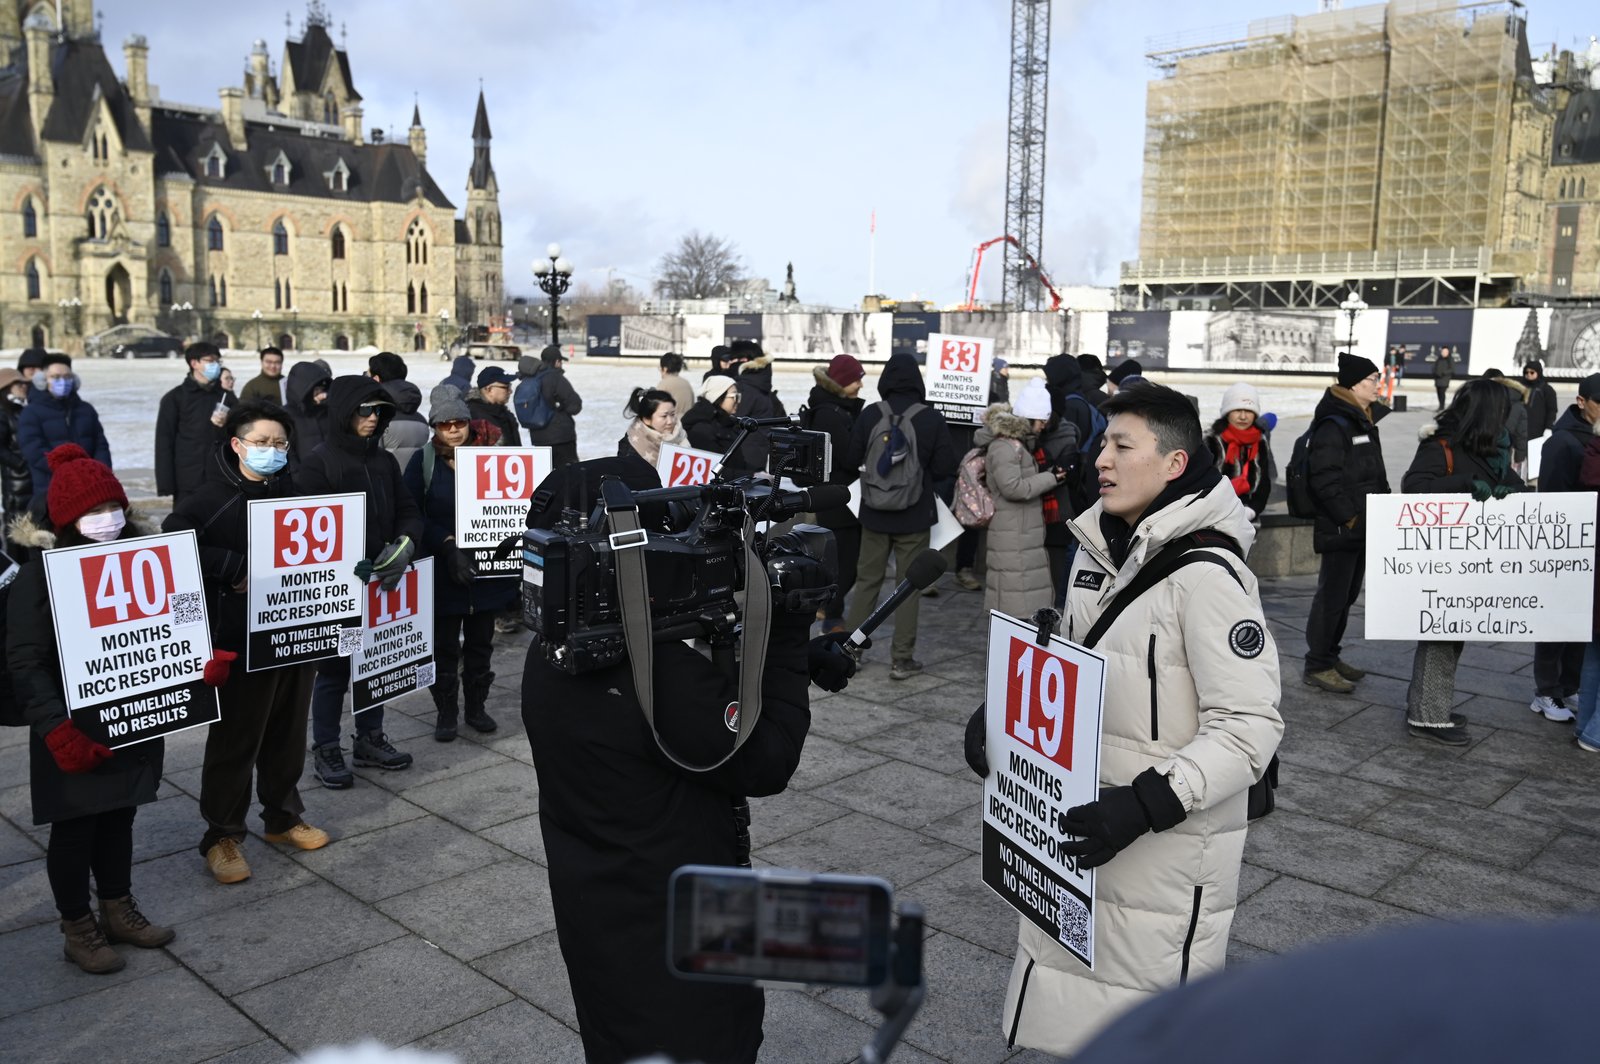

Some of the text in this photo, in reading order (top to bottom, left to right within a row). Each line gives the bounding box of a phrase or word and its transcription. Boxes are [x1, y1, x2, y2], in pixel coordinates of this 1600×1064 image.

[943, 341, 977, 372] 33
[933, 382, 981, 393] WAITING FOR
[942, 374, 973, 383] MONTHS
[928, 390, 984, 402] IRCC RESPONSE
[945, 411, 972, 420] RESULTS
[483, 455, 526, 499] 19
[671, 454, 706, 487] 28
[470, 518, 516, 529] WAITING
[482, 505, 528, 516] MONTHS
[1395, 500, 1567, 527] ASSEZ des délais
[281, 506, 337, 566] 39
[464, 532, 488, 543] IRCC
[1397, 522, 1595, 551] INTERMINABLE
[475, 550, 488, 560] NO
[479, 560, 524, 571] NO RESUL
[705, 555, 728, 565] SONY
[1383, 557, 1593, 578] Nos vies sont en suspens.
[95, 549, 167, 622] 40
[280, 568, 336, 588] MONTHS
[266, 583, 349, 607] WAITING FOR
[376, 573, 411, 625] 11
[1422, 589, 1545, 613] Transparence.
[257, 598, 356, 625] IRCC RESPONSE
[1420, 610, 1534, 634] Délais clairs.
[101, 624, 172, 652] MONTHS
[270, 624, 342, 646] NO TIMELINES
[363, 631, 423, 660] WAITING FOR
[373, 621, 414, 643] MONTHS
[85, 640, 192, 676] WAITING FOR
[274, 637, 338, 658] NO RESULTS
[358, 642, 429, 676] IRCC RESPONSE
[78, 657, 204, 700] IRCC RESPONSE
[367, 663, 419, 690] NO TIMELINES
[371, 675, 416, 700] NO RESULTS
[99, 688, 192, 723] NO TIMELINES
[1013, 645, 1065, 758] 19
[108, 706, 189, 738] NO RESULTS
[1009, 750, 1063, 803] MONTHS
[989, 794, 1015, 830] IRCC
[996, 770, 1076, 841] WAITING FO
[999, 842, 1062, 904] NO TIMELINE
[1003, 868, 1017, 893] NO
